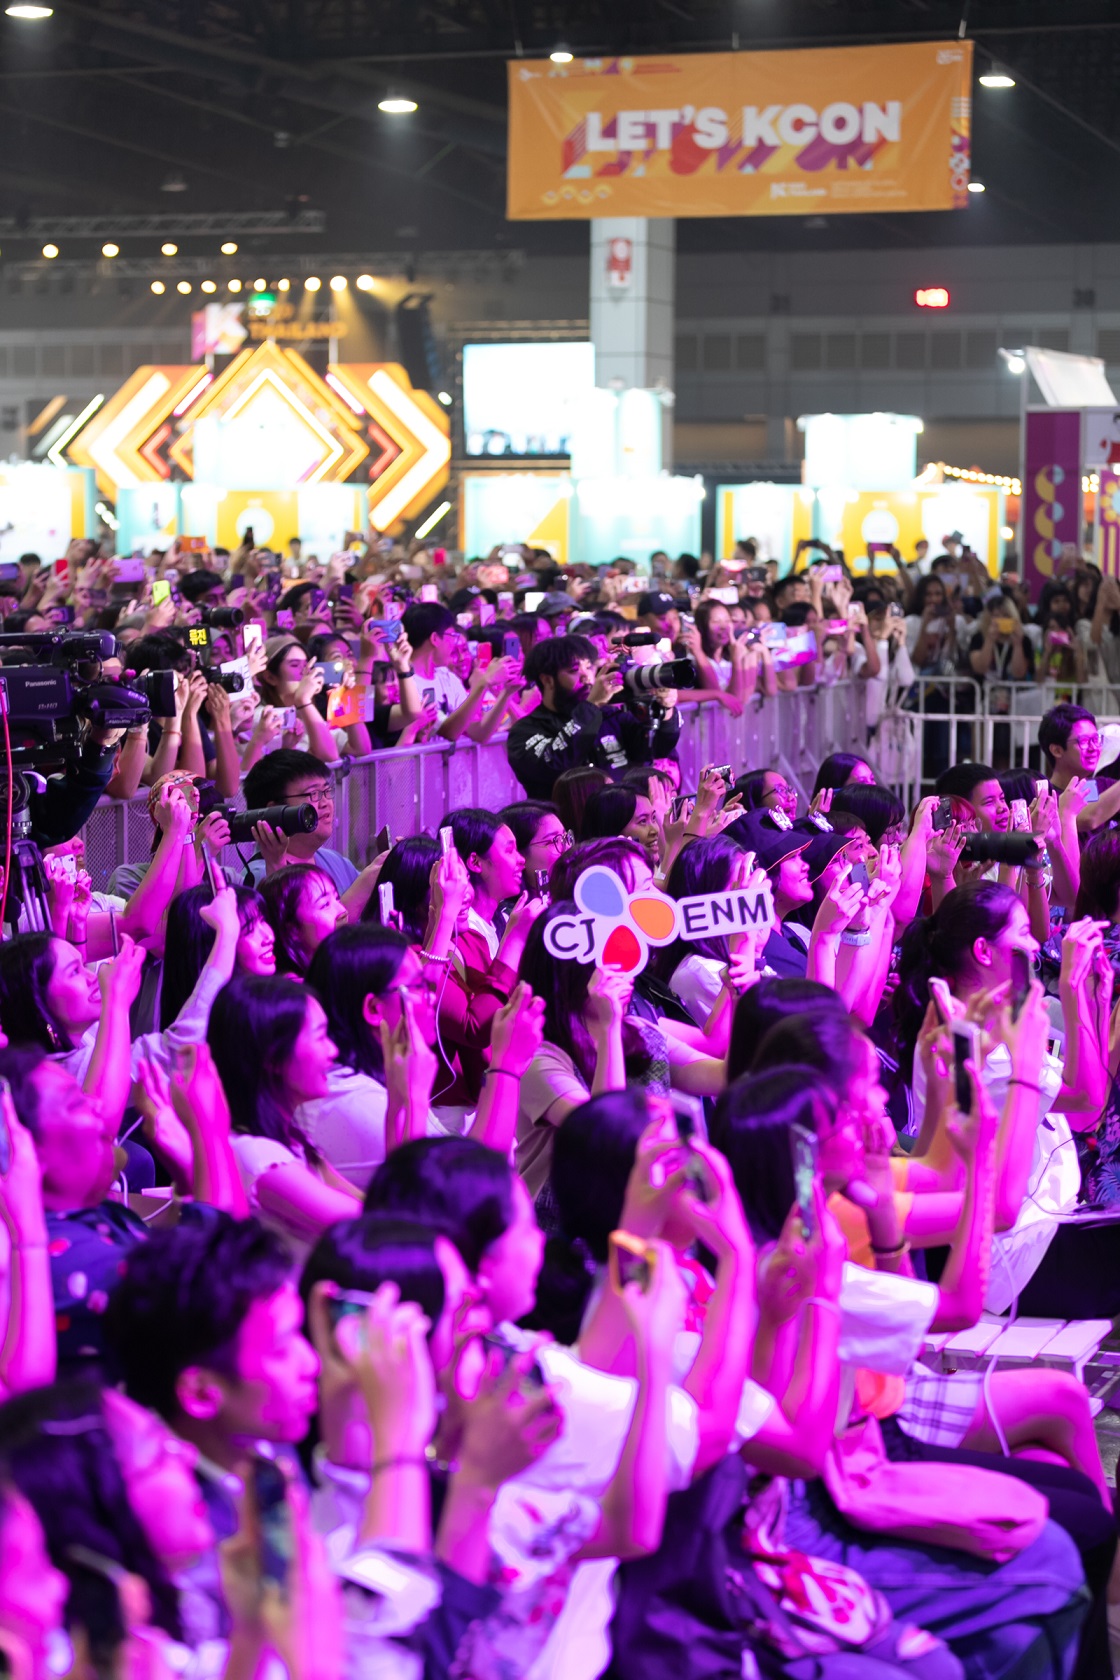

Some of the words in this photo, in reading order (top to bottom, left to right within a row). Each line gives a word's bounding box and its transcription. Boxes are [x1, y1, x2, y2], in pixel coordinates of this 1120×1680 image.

[586, 104, 728, 151] LET'S
[742, 101, 901, 147] KCON
[25, 679, 57, 688] Panasonic
[550, 917, 596, 957] CJ
[682, 893, 768, 934] ENM
